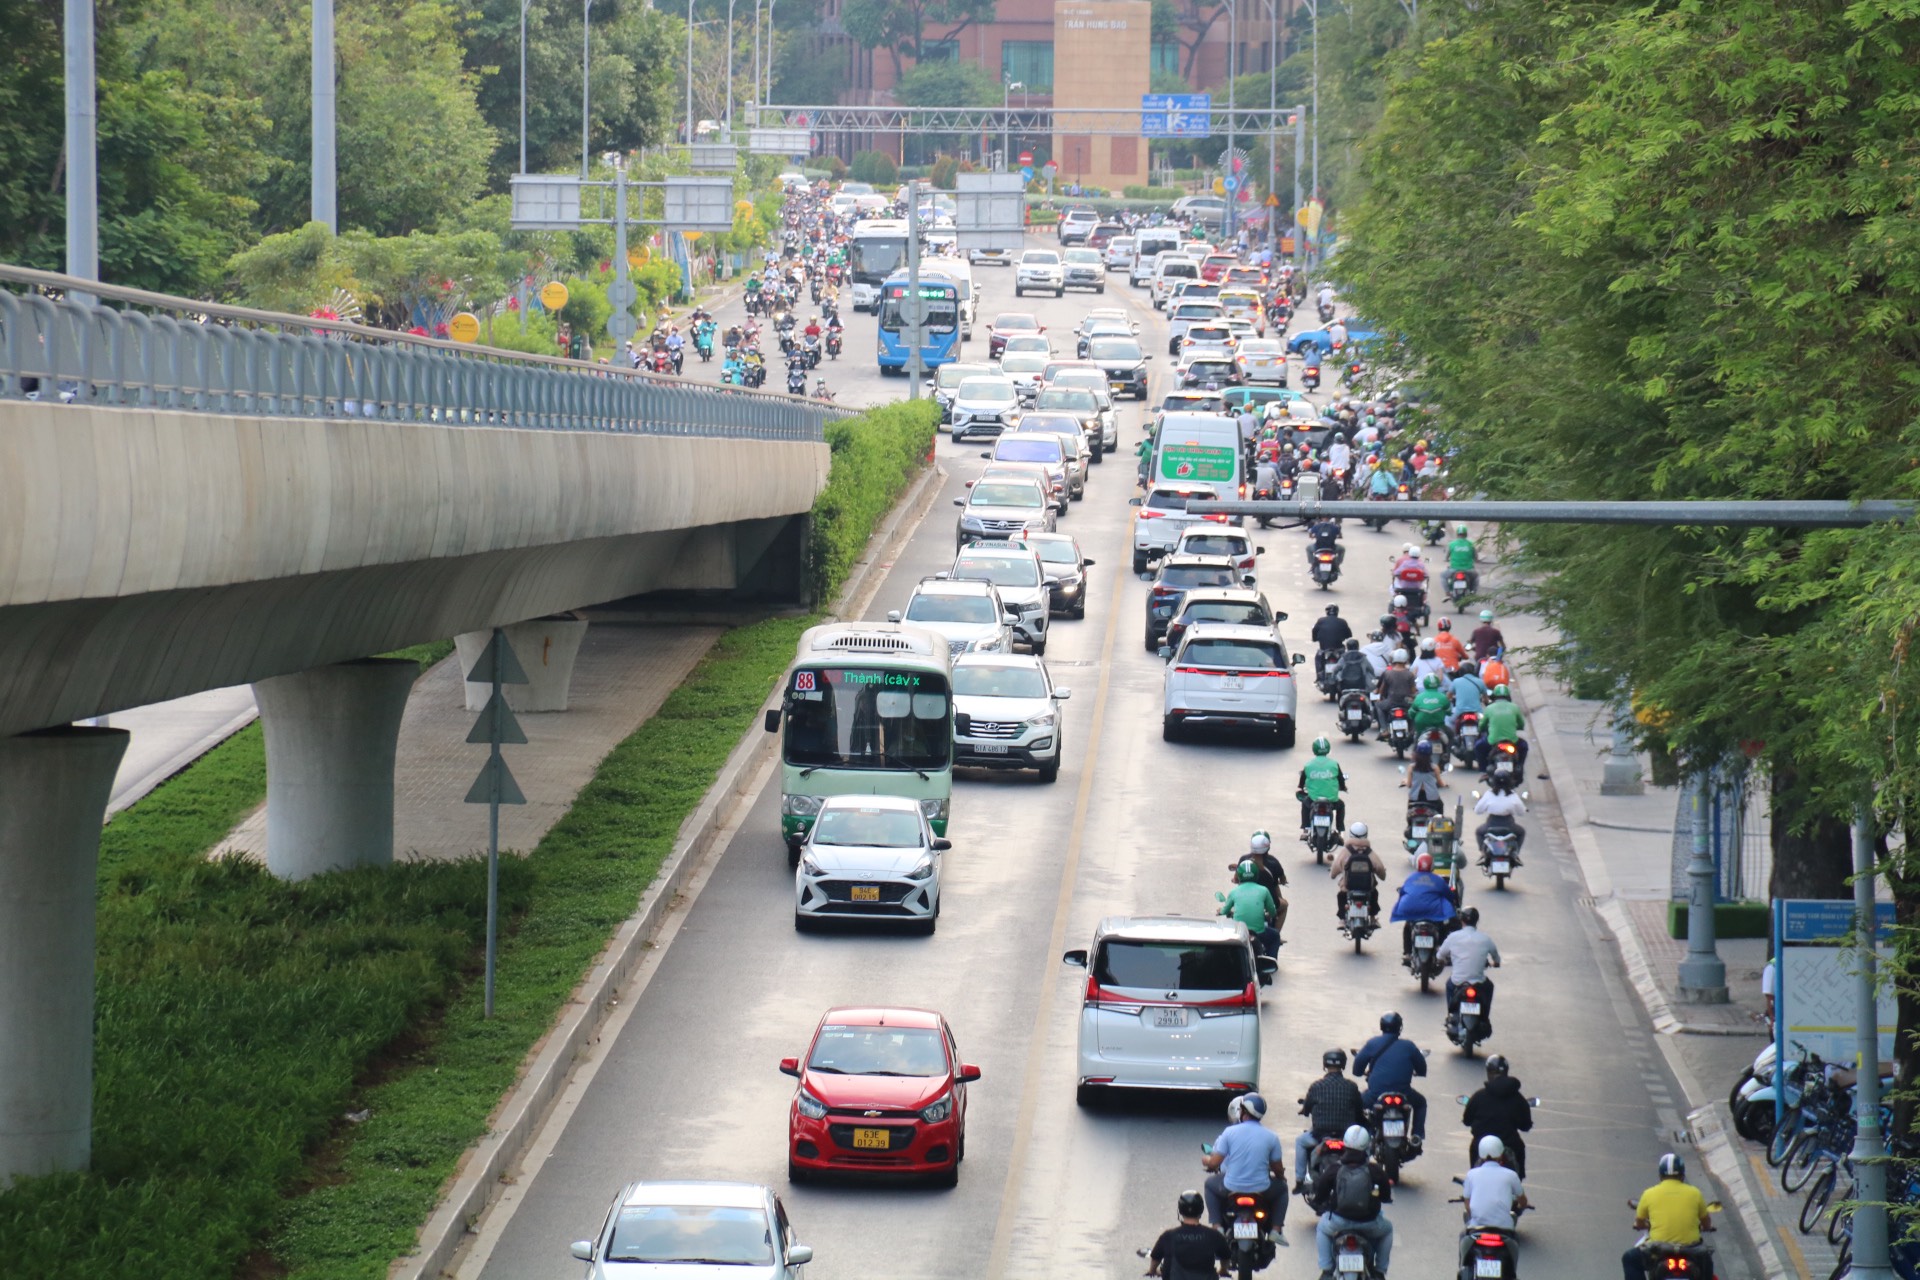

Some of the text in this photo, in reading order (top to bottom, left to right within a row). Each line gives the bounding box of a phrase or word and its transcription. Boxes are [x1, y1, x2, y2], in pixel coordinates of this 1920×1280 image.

[798, 673, 813, 689] 88
[844, 671, 881, 685] Thành
[913, 677, 920, 686] x
[1309, 769, 1334, 780] Grab
[1164, 1009, 1177, 1017] 51K
[863, 1130, 880, 1139] 63E
